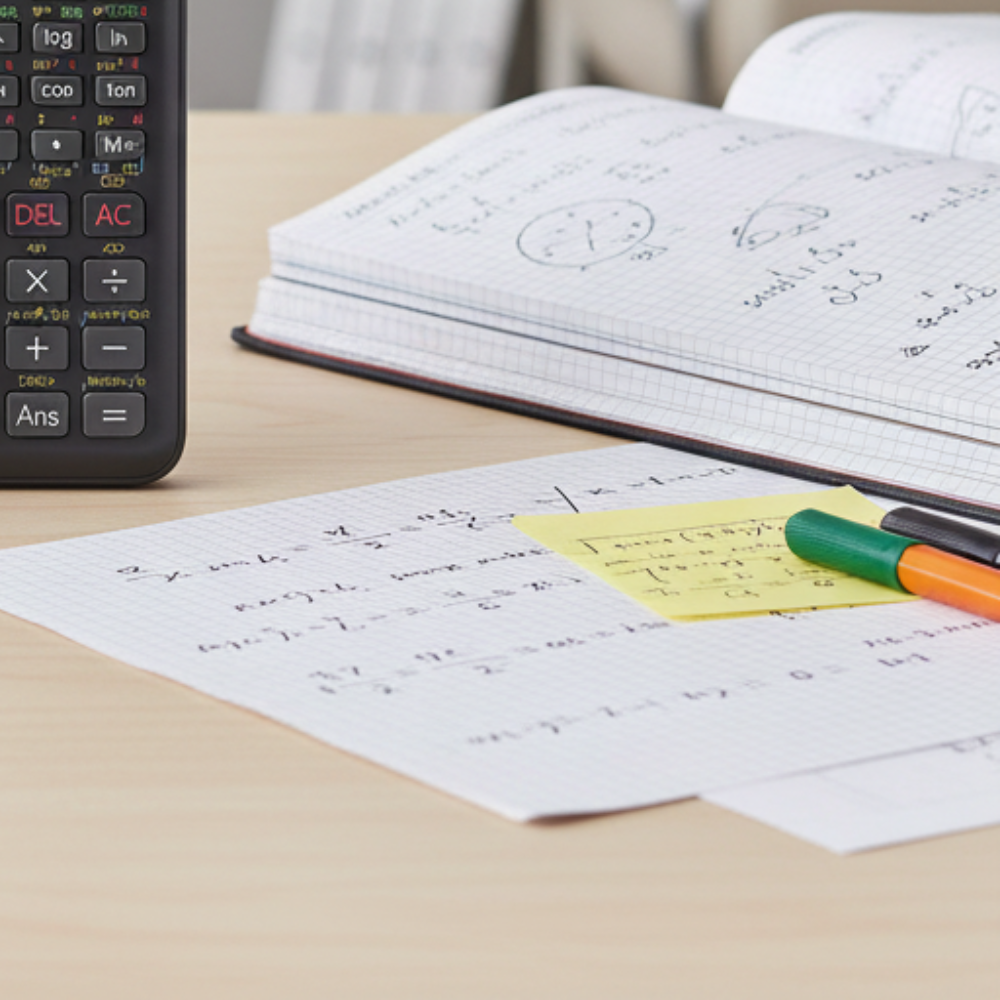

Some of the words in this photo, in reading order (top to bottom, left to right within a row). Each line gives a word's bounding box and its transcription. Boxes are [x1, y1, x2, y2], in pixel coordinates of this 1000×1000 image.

[44, 28, 73, 50] log
[14, 203, 62, 226] DEL
[95, 203, 132, 226] AC
[15, 403, 60, 427] Ans
